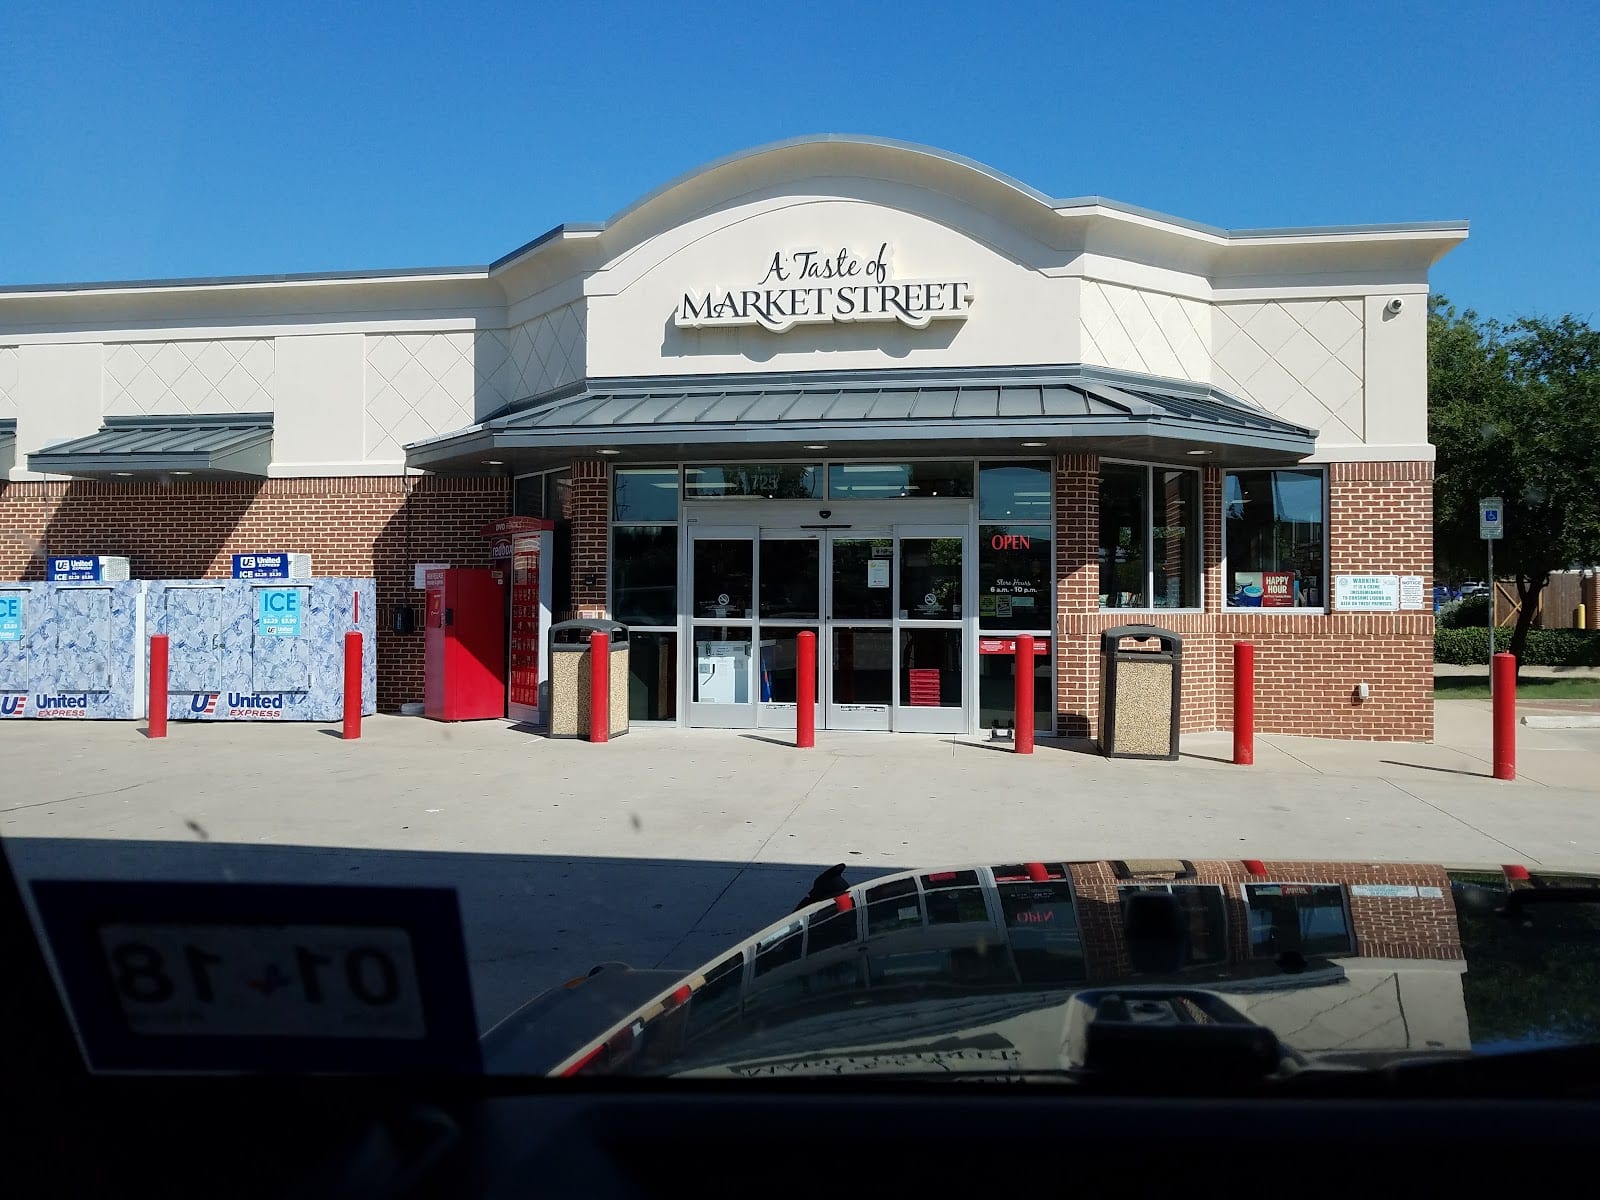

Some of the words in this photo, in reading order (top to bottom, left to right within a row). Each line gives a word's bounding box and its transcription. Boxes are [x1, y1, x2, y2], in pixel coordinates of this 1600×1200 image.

[758, 251, 789, 285] A
[793, 247, 860, 279] Taste
[866, 242, 887, 284] of
[680, 287, 833, 324] MARKET
[836, 282, 969, 320] STREET
[991, 534, 1030, 551] OPEN
[256, 556, 281, 565] United
[1265, 576, 1290, 585] HAPPY
[1267, 585, 1288, 594] HOUR
[0, 599, 17, 617] CE
[264, 592, 296, 611] ICE
[36, 693, 88, 709] United
[227, 692, 283, 709] United
[38, 709, 86, 717] EXPRESS
[229, 709, 281, 718] EXPRESS
